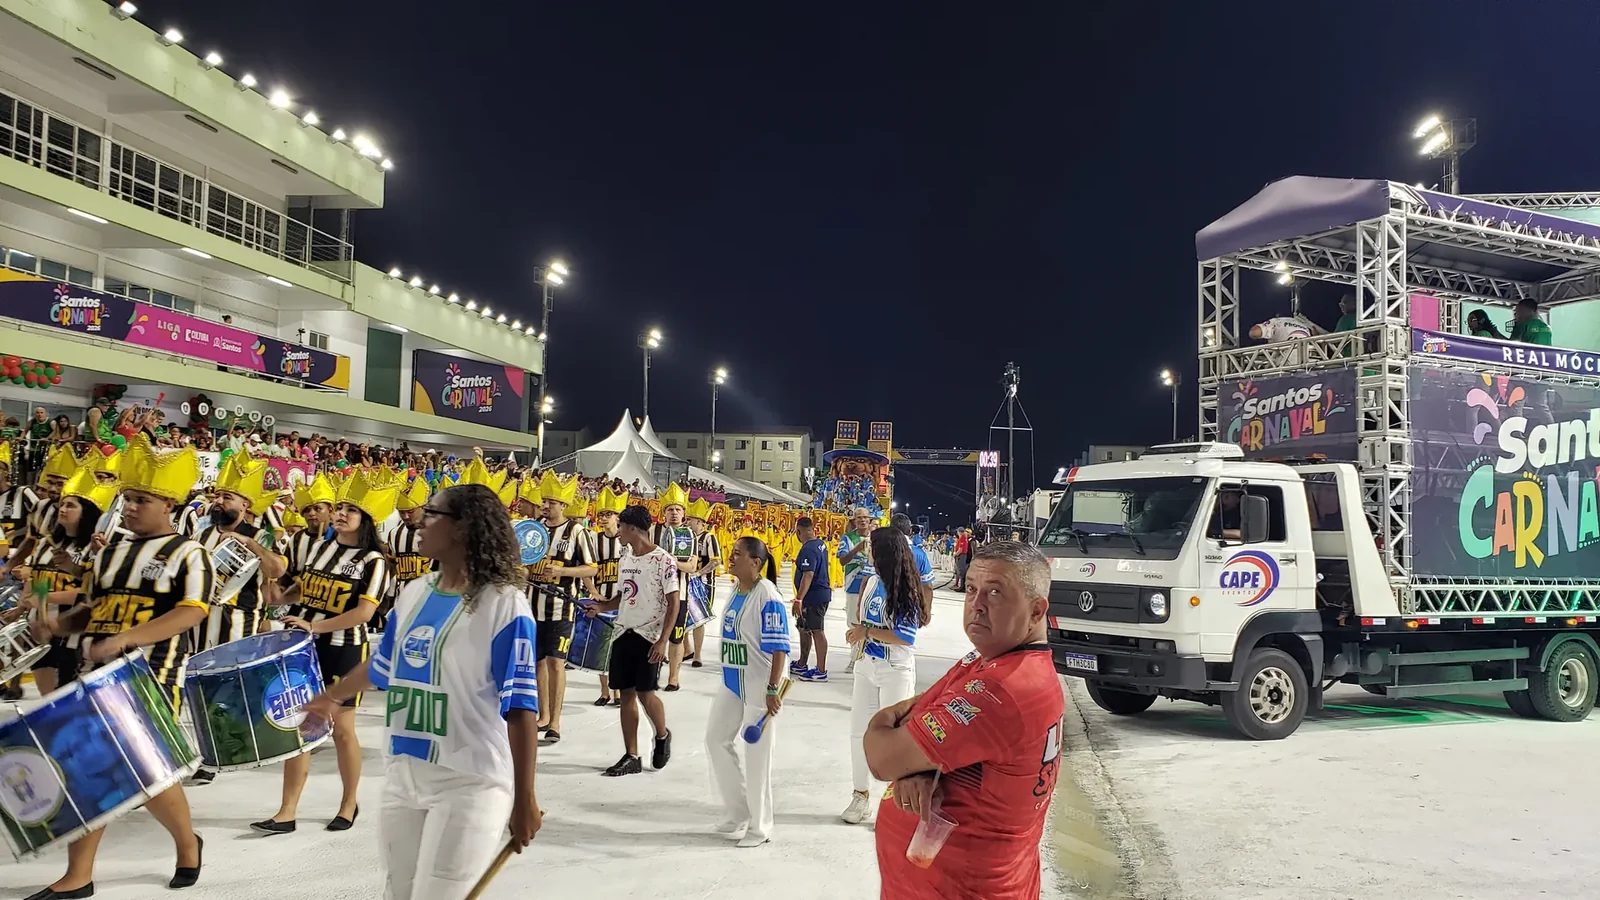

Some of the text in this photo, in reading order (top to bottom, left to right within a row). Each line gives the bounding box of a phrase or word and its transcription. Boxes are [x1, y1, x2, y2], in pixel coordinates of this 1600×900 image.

[60, 295, 101, 308] Santos
[50, 303, 101, 327] CARNAVAL
[157, 320, 181, 334] LIGA
[286, 351, 310, 360] Santos
[1502, 346, 1550, 367] REAL
[451, 375, 492, 389] Santos
[441, 384, 493, 410] CARNAVAL
[1241, 383, 1323, 420] Santos
[1227, 401, 1326, 452] CARNAVAL
[980, 450, 998, 468] 00:39
[1458, 464, 1600, 569] CARNA
[1219, 570, 1261, 588] CAPE
[674, 626, 684, 640] 10
